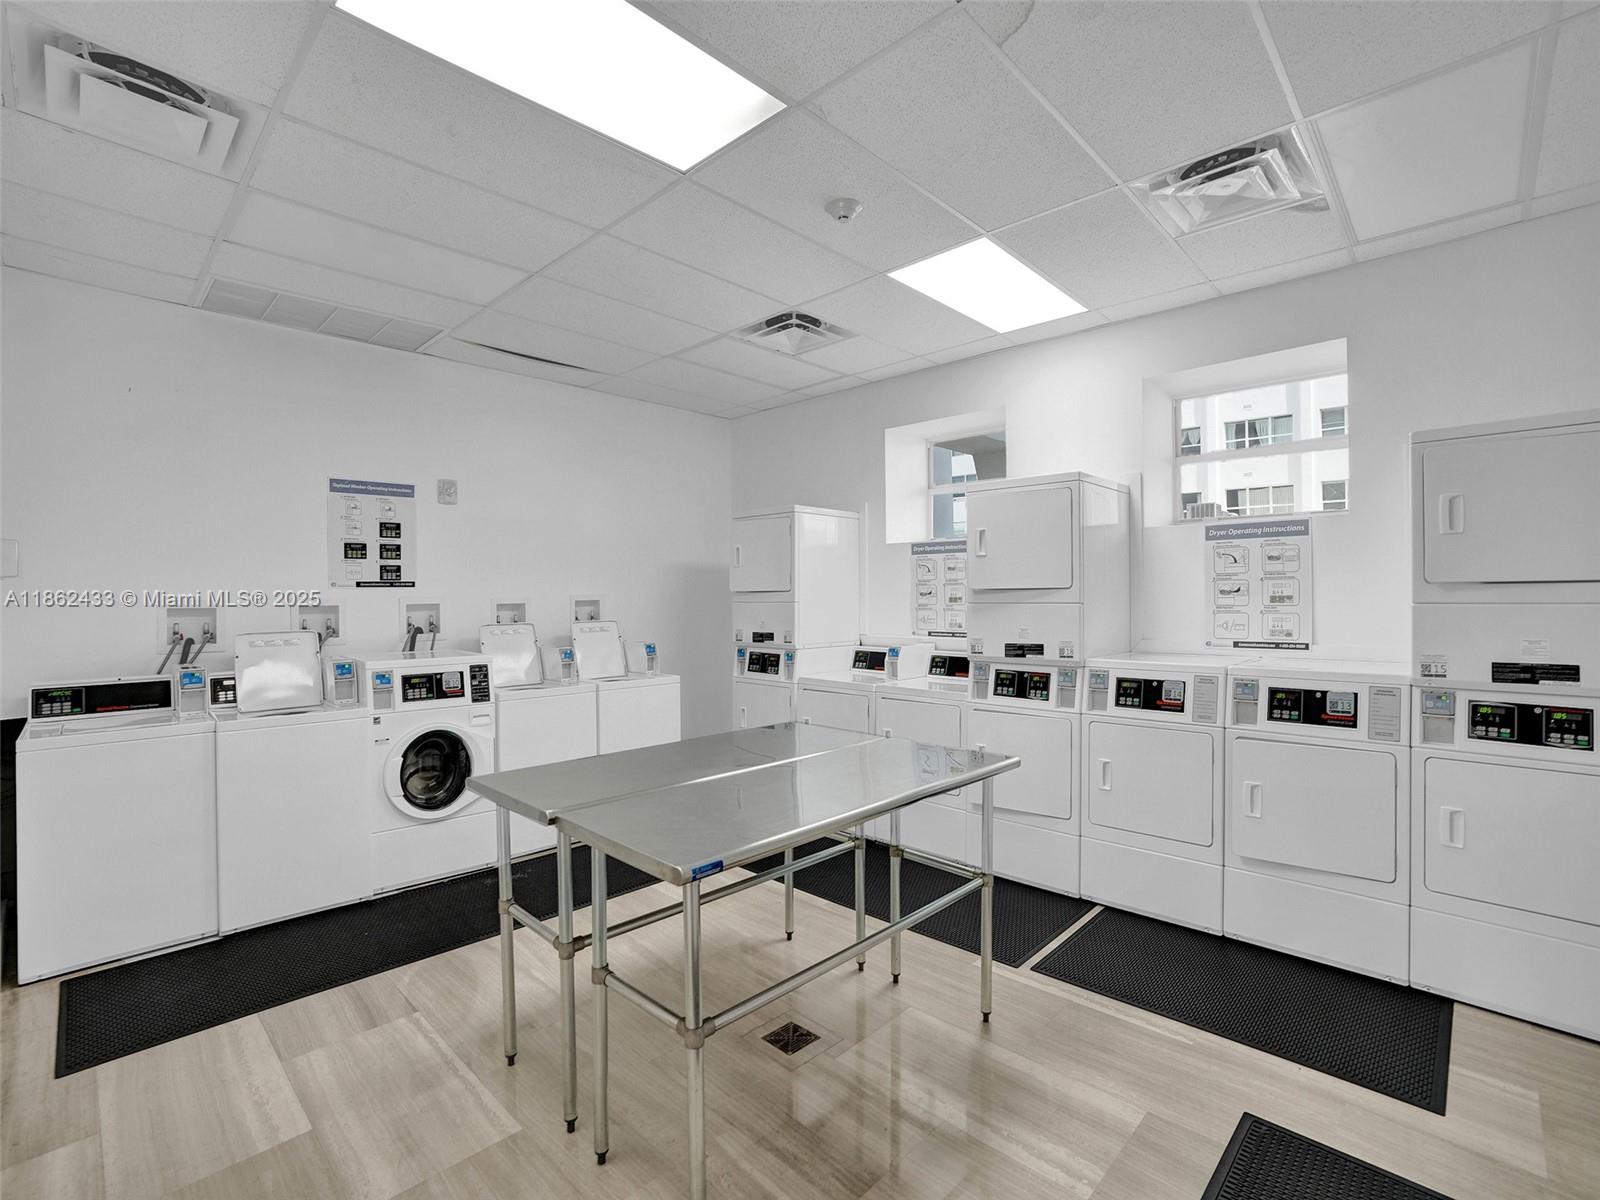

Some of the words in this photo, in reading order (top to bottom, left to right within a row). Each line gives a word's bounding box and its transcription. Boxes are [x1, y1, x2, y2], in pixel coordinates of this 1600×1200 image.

[1228, 526, 1262, 535] Operating
[1262, 524, 1304, 533] Instructions
[1434, 664, 1446, 673] 15
